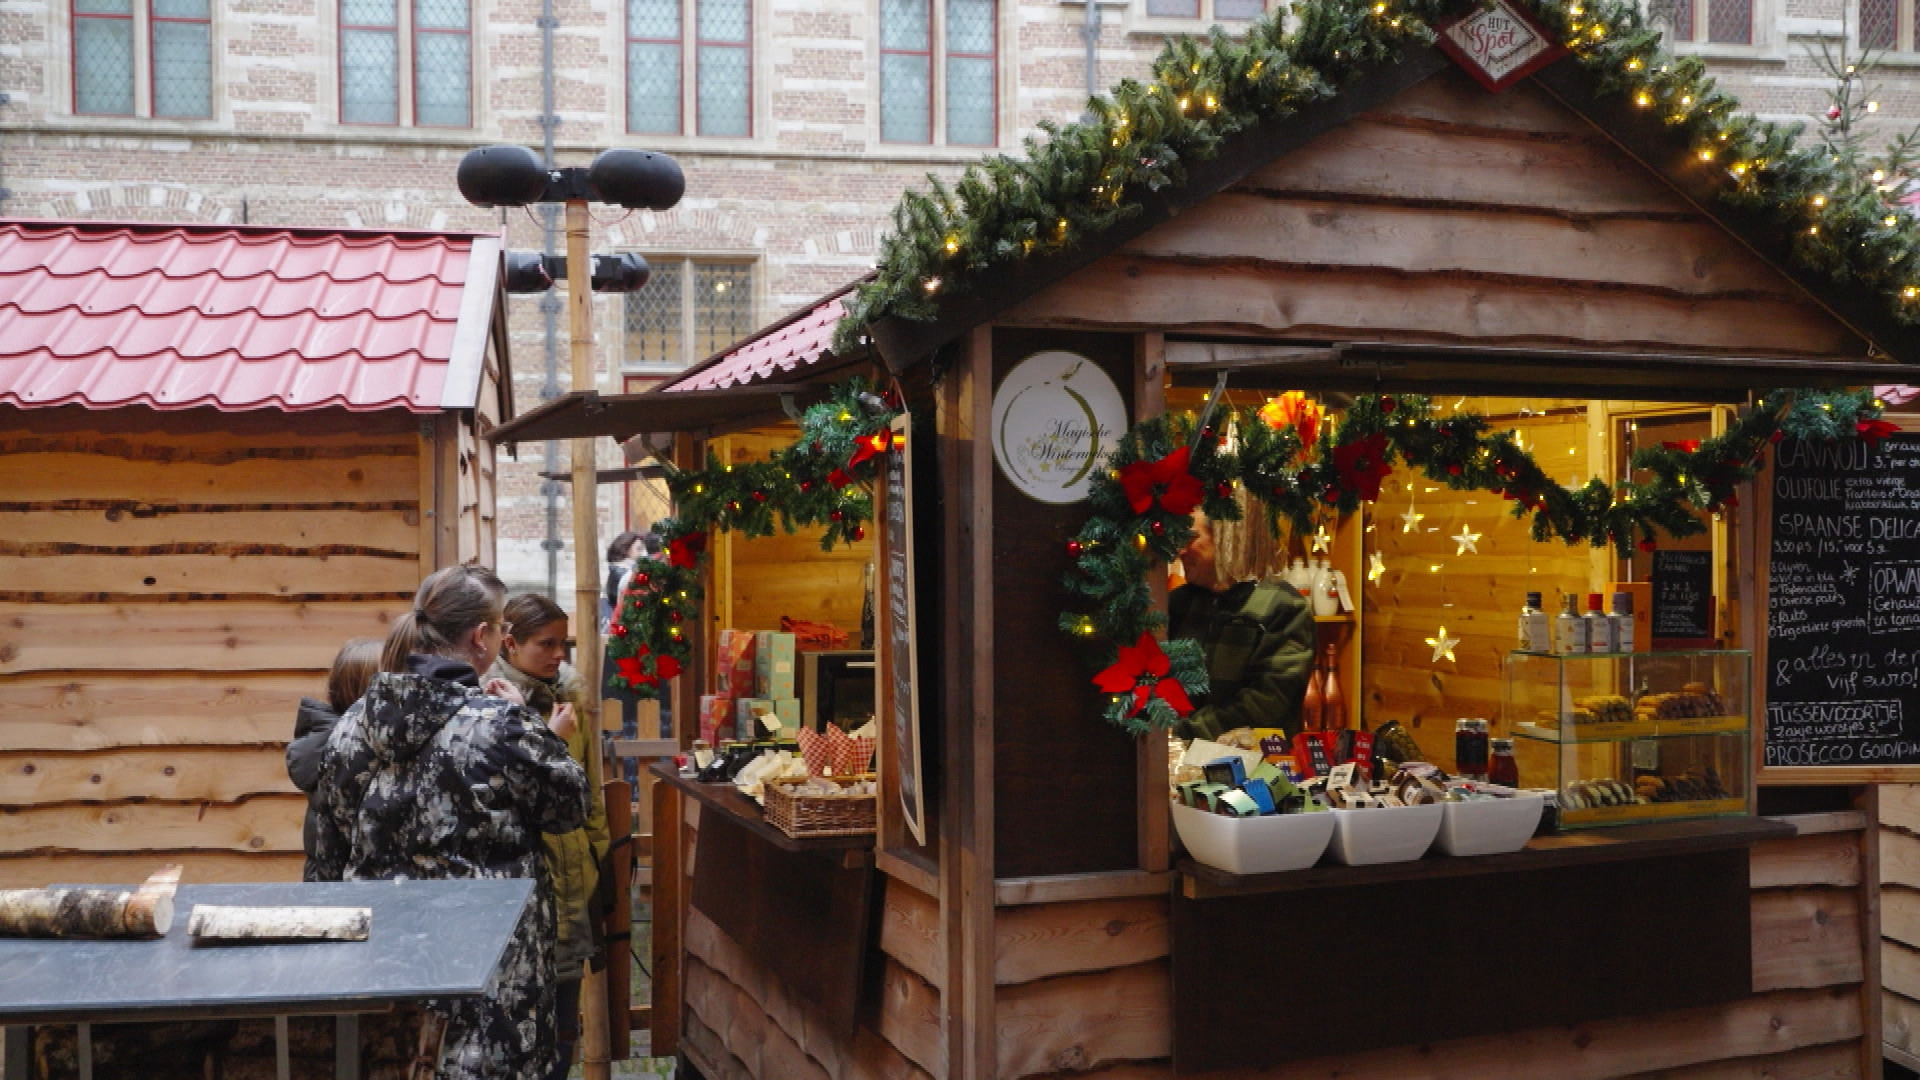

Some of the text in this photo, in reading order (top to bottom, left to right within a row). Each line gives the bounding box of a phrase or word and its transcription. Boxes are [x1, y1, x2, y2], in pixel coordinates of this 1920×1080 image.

[1488, 18, 1510, 30] HUT
[1471, 24, 1517, 64] Spot
[1778, 439, 1867, 471] CANNOLI
[1779, 513, 1863, 538] SPAANSE
[1776, 658, 1792, 687] &
[1793, 643, 1846, 672] alles
[1769, 703, 1898, 724] TUSSENDOORTJE
[1766, 744, 1853, 766] PROSECCO
